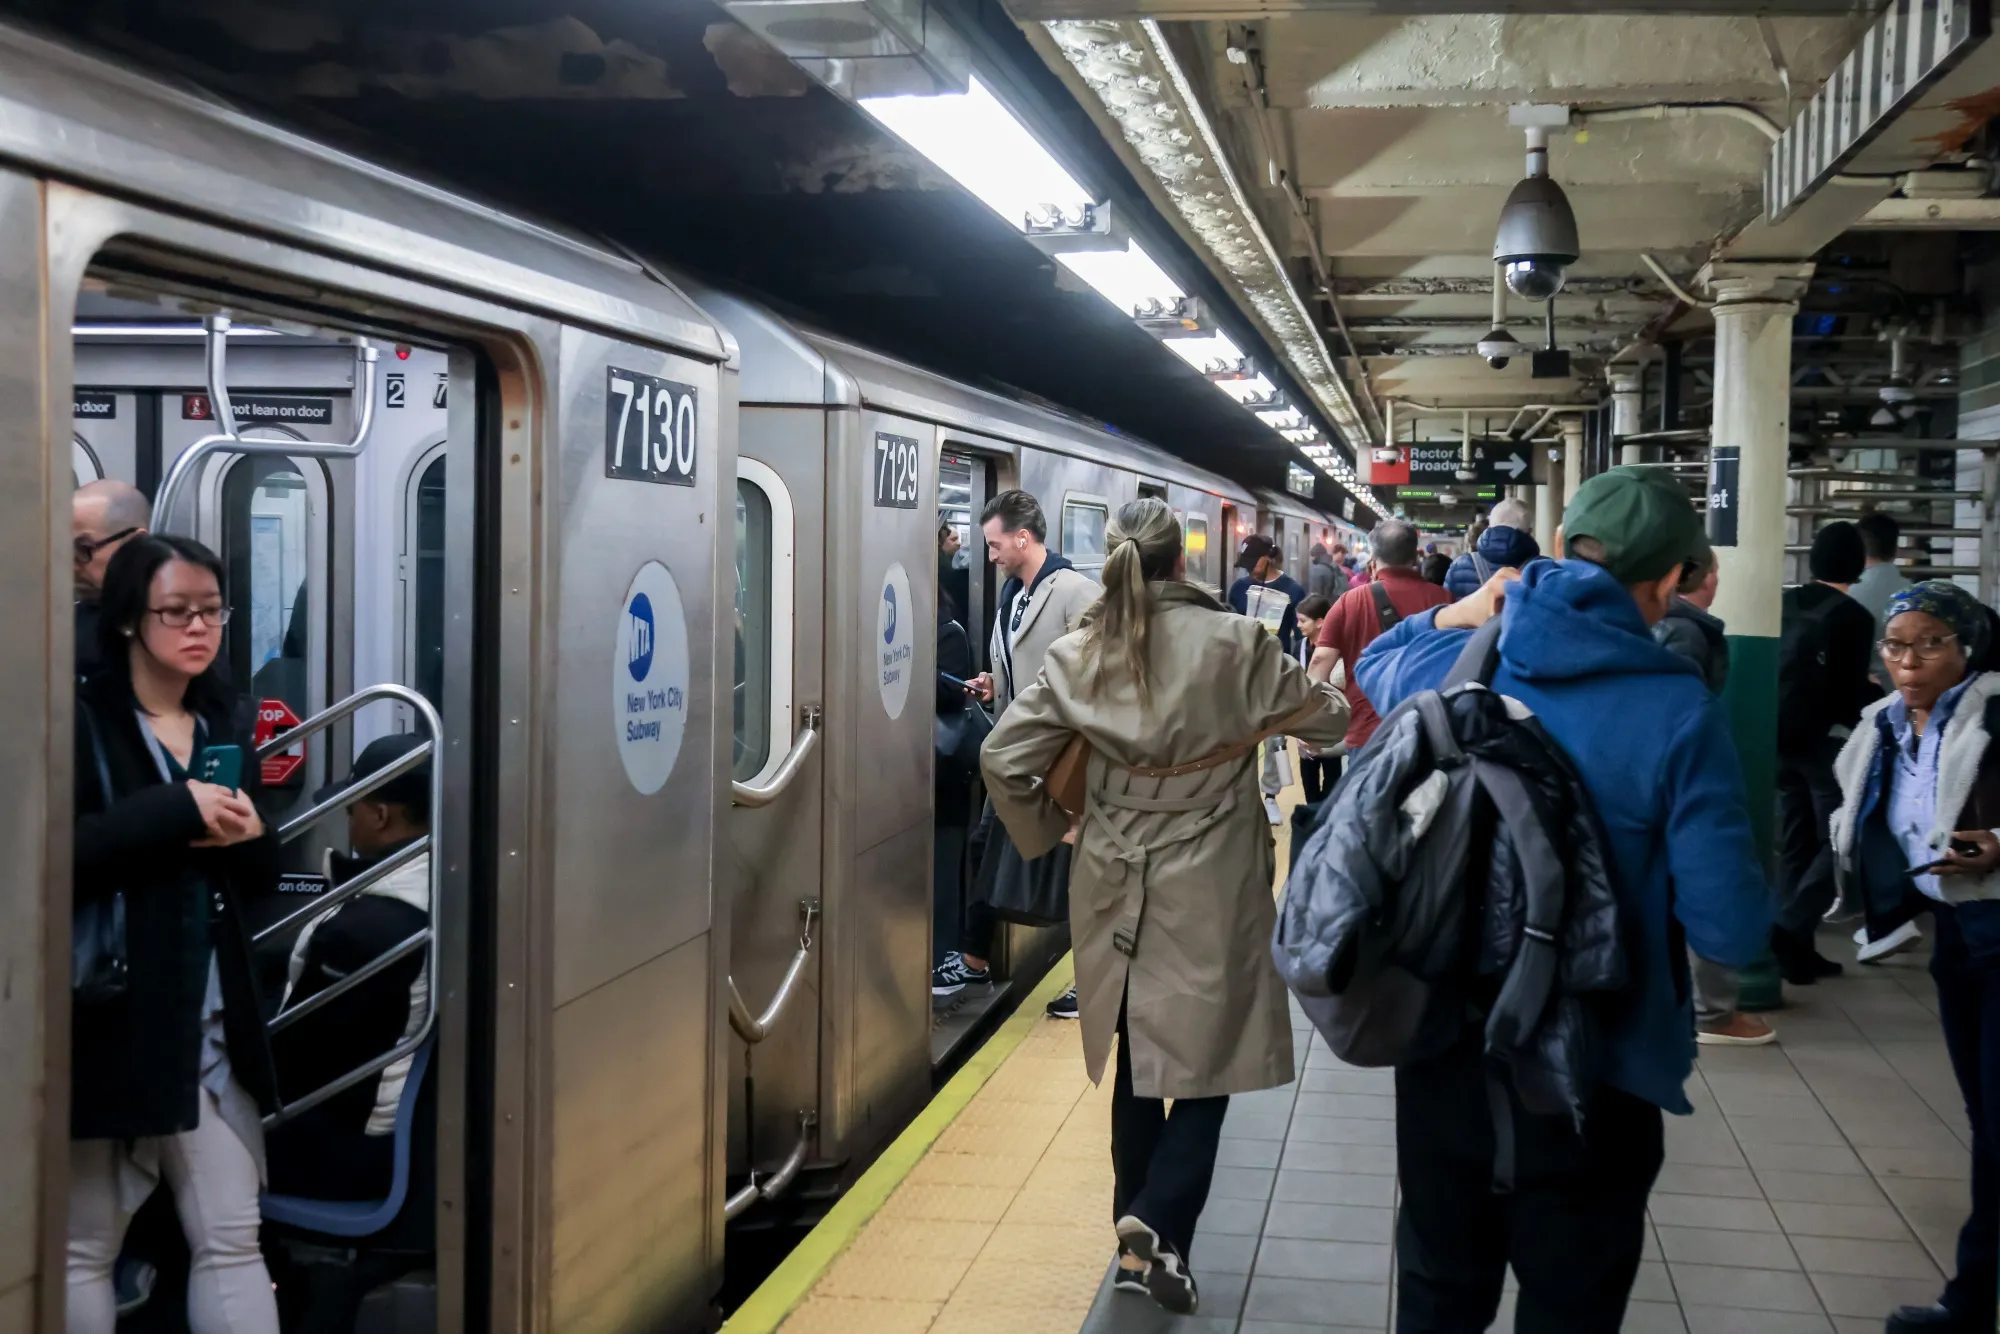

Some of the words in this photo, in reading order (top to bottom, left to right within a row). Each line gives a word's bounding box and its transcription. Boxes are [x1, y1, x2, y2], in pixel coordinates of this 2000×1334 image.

[388, 380, 405, 405] 2
[82, 400, 111, 413] door
[231, 403, 251, 416] not
[252, 403, 279, 417] lean
[279, 406, 296, 418] on
[297, 405, 326, 418] door
[611, 377, 695, 475] 7130
[1410, 447, 1454, 459] Rector
[1475, 447, 1485, 459] &
[878, 439, 917, 501] 7129
[1410, 459, 1476, 472] Broadw
[883, 652, 892, 667] New
[893, 646, 902, 663] York
[902, 644, 911, 660] City
[883, 669, 901, 685] Subway
[627, 692, 646, 713] New
[647, 688, 666, 710] York
[667, 686, 684, 712] City
[259, 709, 285, 722] TOP
[627, 719, 662, 741] Subway
[279, 882, 294, 892] on
[296, 881, 324, 893] door
